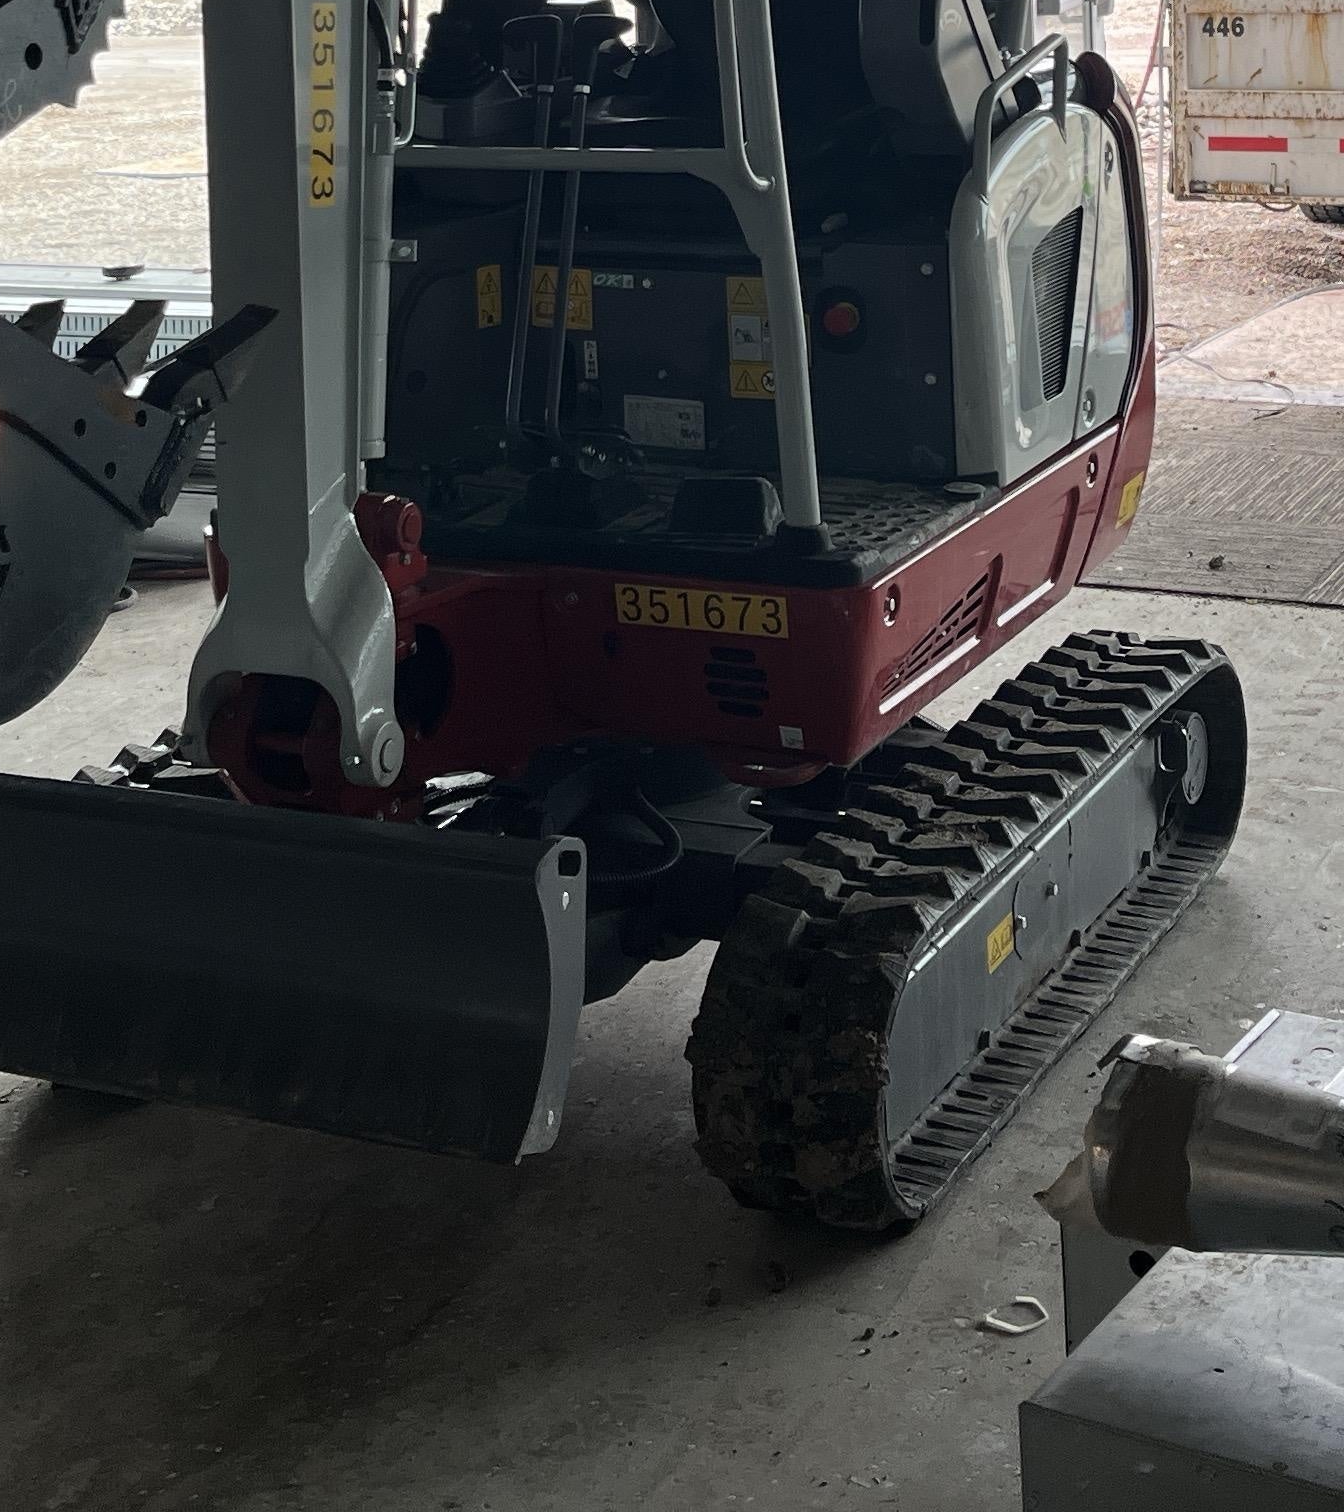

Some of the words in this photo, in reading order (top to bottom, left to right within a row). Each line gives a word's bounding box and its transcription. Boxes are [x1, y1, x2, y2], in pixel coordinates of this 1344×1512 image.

[1202, 17, 1244, 37] 446
[311, 10, 335, 200] 351673
[620, 586, 784, 635] 351673
